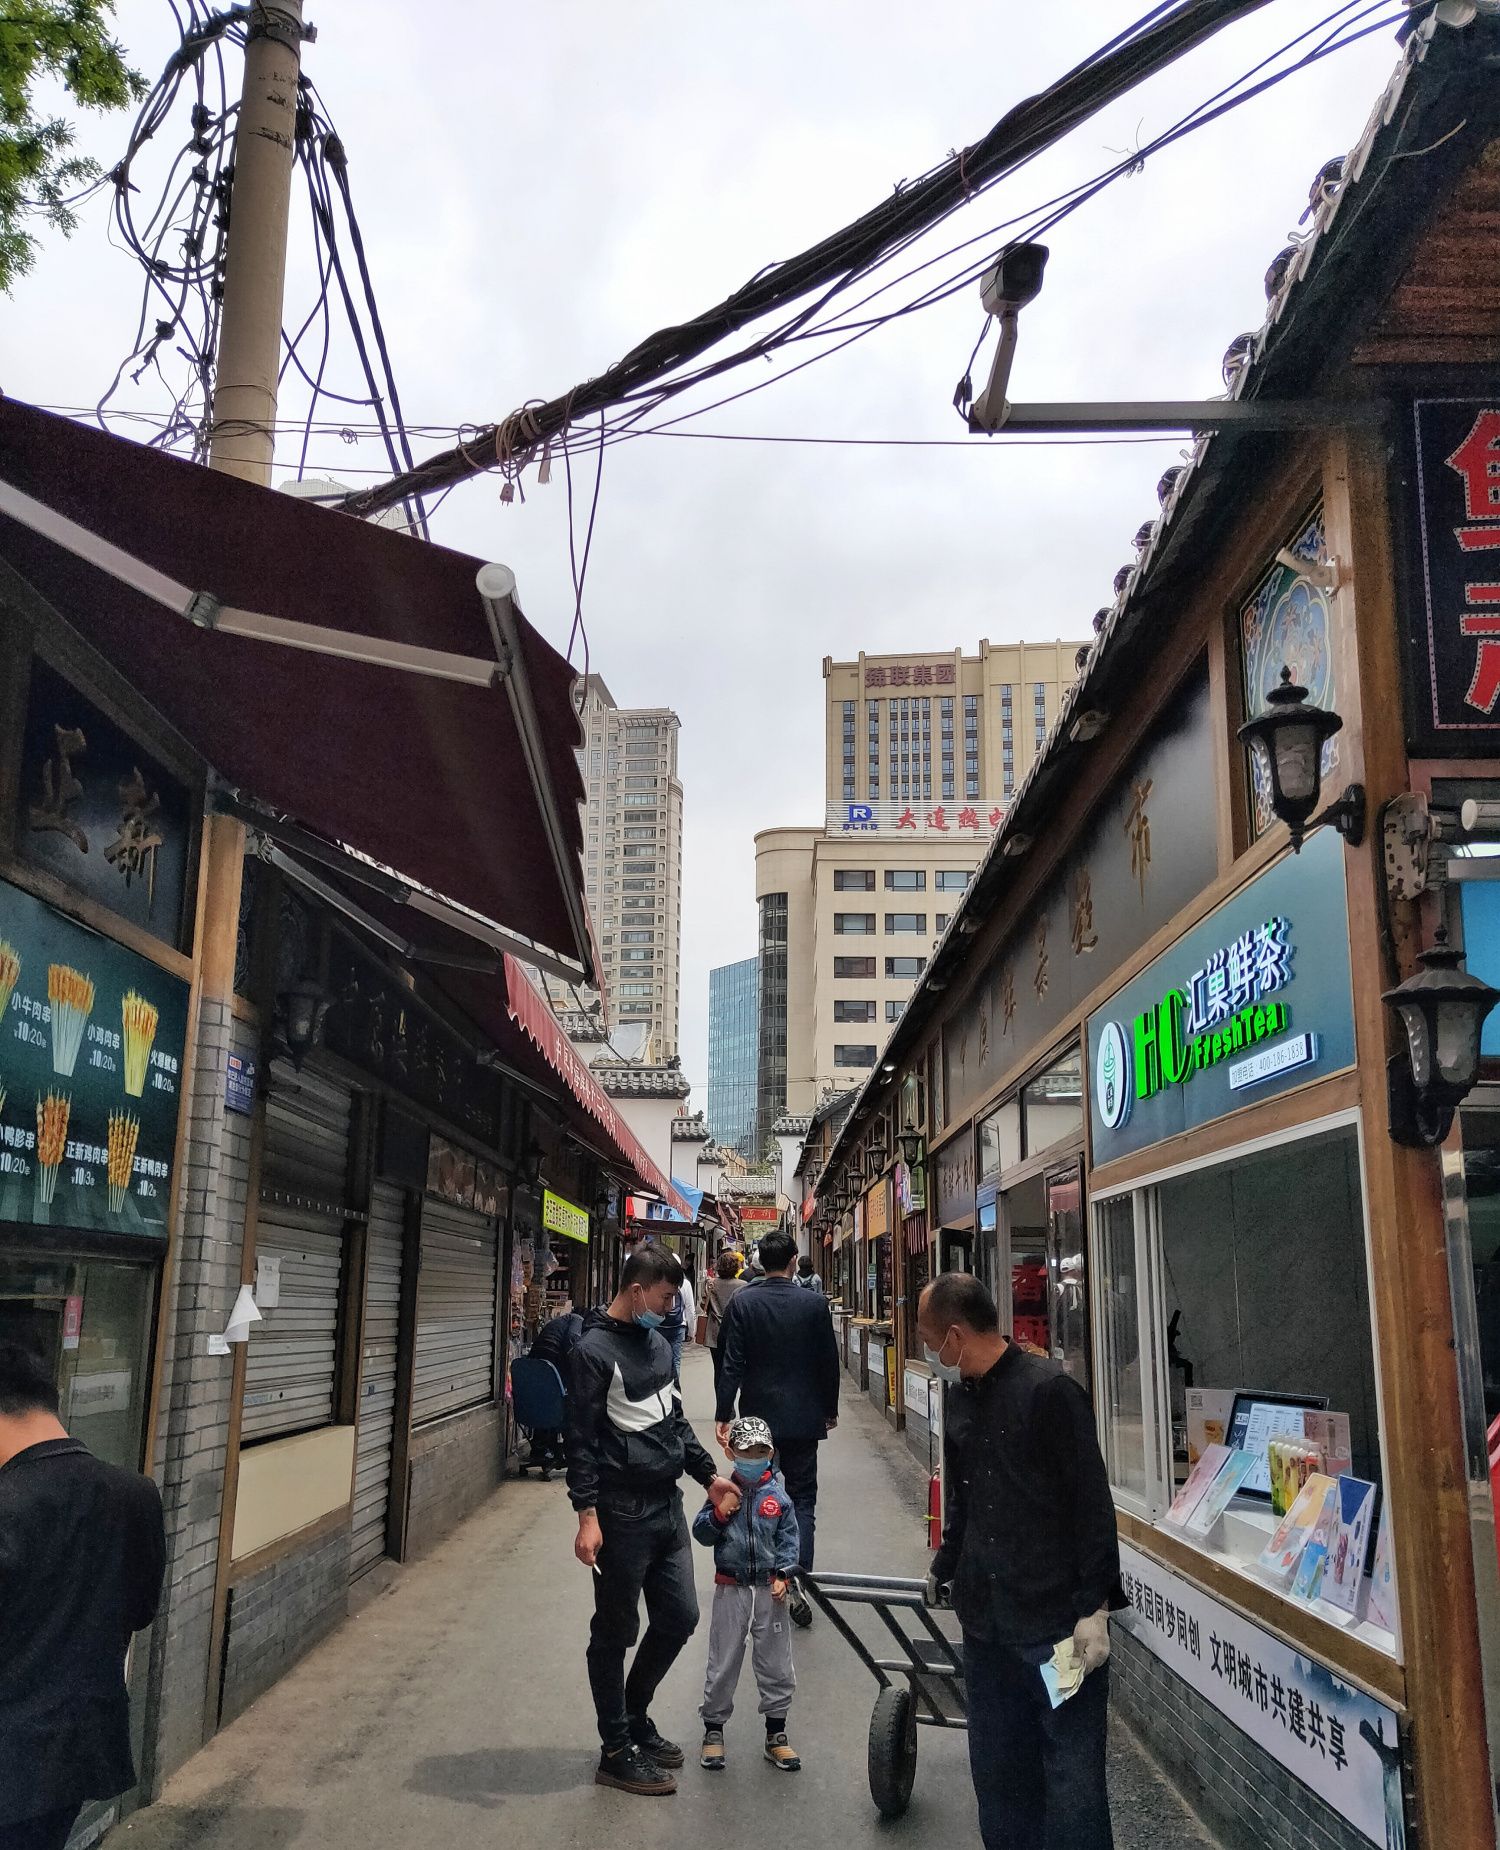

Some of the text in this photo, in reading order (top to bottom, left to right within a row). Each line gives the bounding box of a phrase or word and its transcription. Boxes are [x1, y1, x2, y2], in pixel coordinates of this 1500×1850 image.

[1186, 915, 1292, 1035] 汇果鲜茶
[11, 991, 52, 1024] 小牛肉串
[87, 1024, 121, 1050] 小鸡肉串
[1133, 987, 1194, 1100] HC
[66, 1140, 109, 1166] 正新鸡肉串
[133, 1156, 169, 1178] 正新鸭肉串
[1209, 1630, 1350, 1771] 文明城市共建共享
